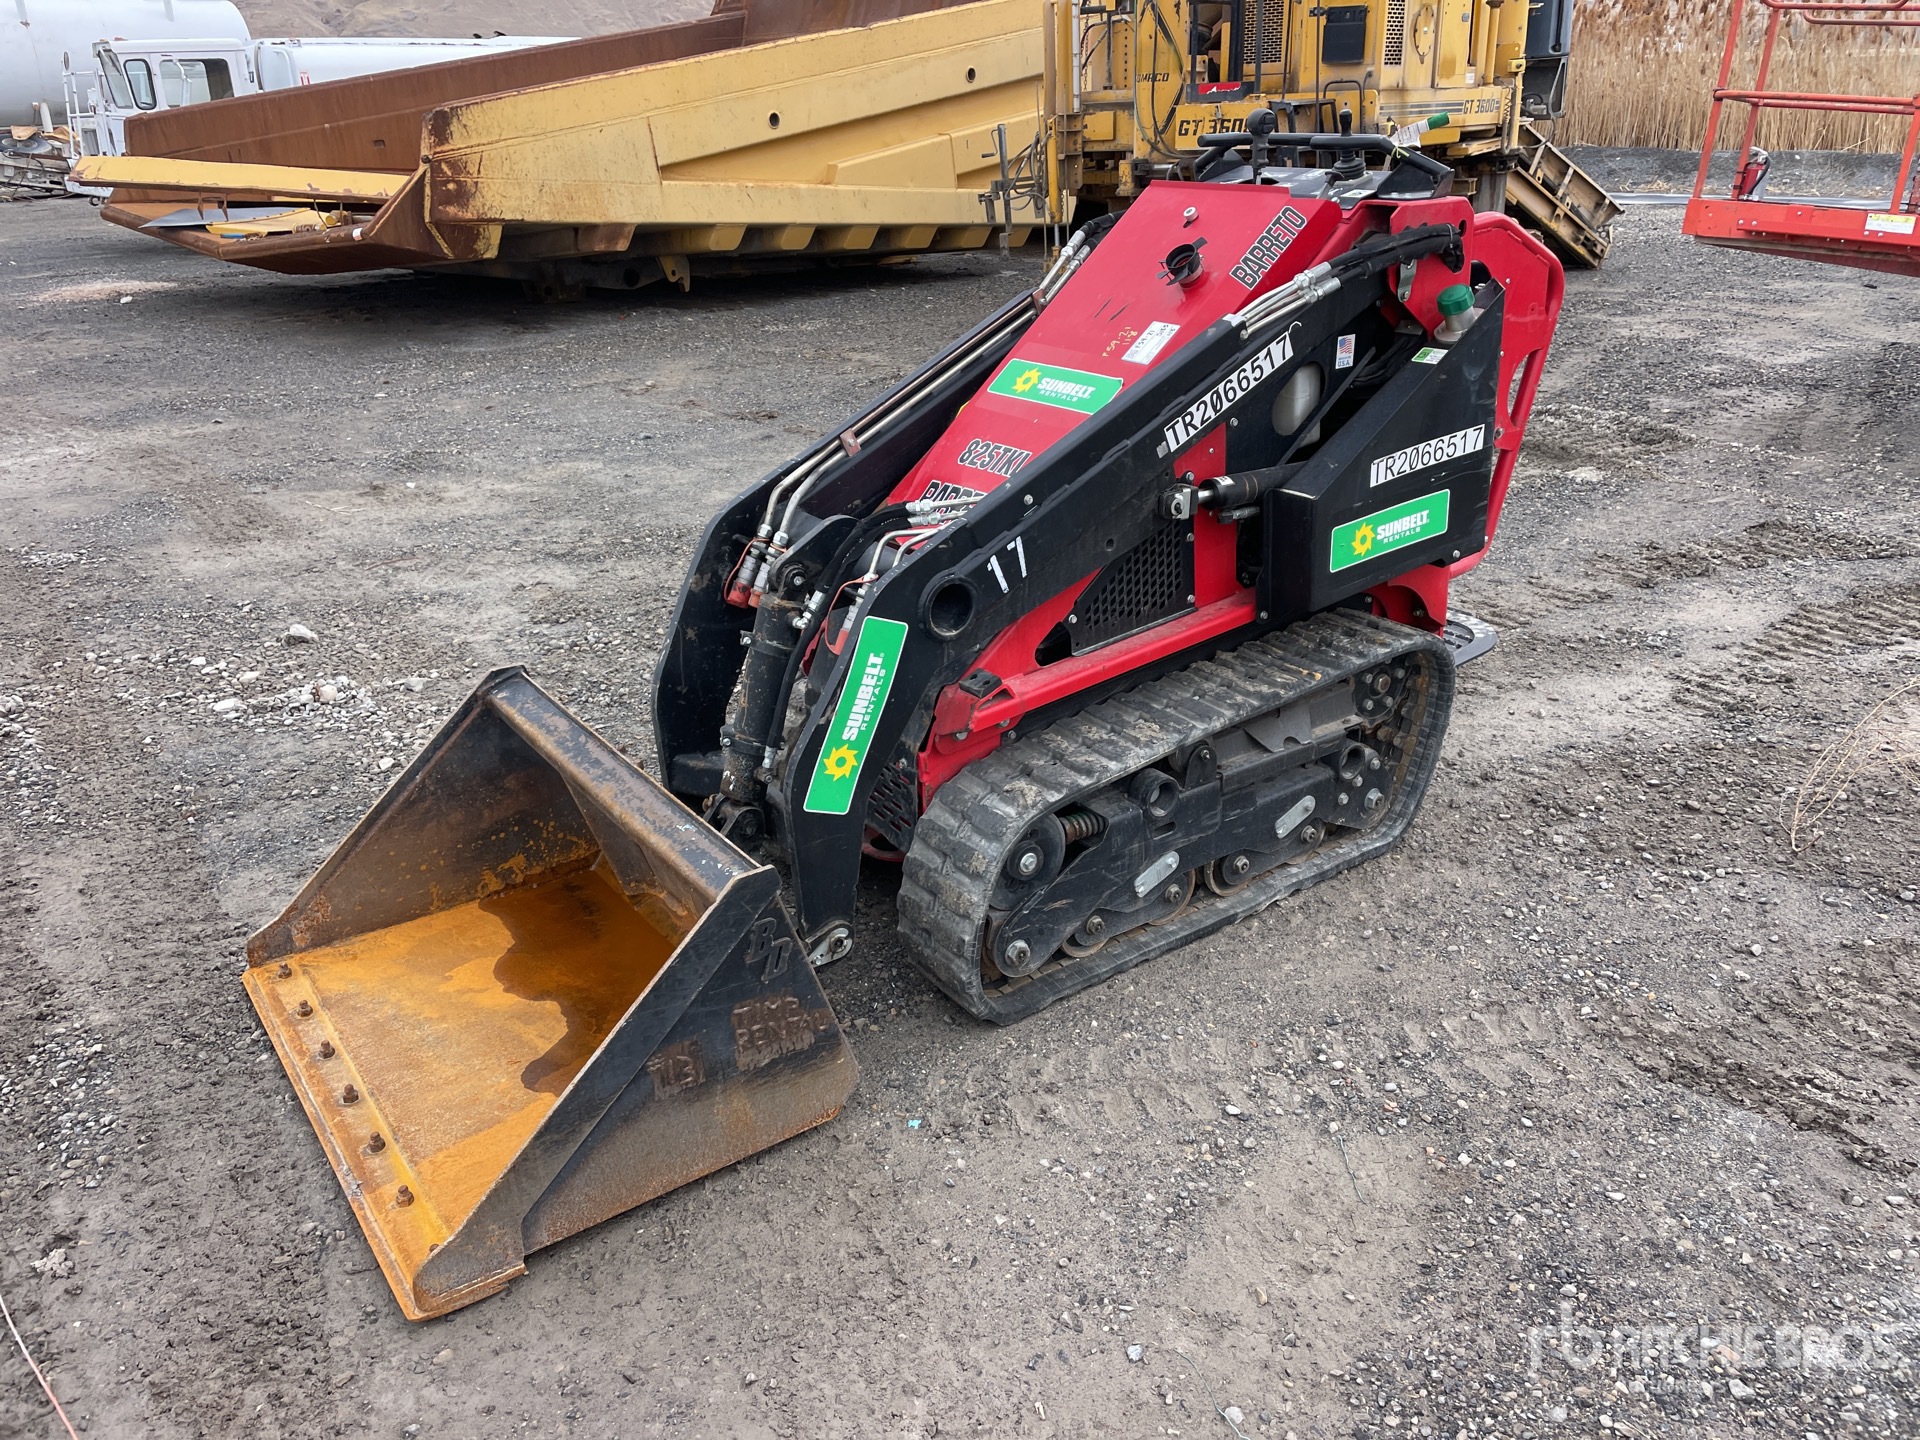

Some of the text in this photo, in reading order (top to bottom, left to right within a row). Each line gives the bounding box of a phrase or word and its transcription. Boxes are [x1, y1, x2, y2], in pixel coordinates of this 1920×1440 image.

[1178, 118, 1250, 136] GT 360
[1463, 98, 1496, 114] GT 3600
[1229, 206, 1307, 290] BARRETO
[1037, 377, 1096, 399] SUNBELT
[1039, 388, 1078, 402] RENTALS
[1166, 335, 1288, 447] TR2066517
[1372, 427, 1483, 484] TR2066517
[1376, 510, 1430, 540] SUNBELT
[1383, 527, 1421, 544] RENTALS
[986, 535, 1027, 594] 17
[842, 653, 884, 741] SUNBELT
[860, 669, 886, 731] RENTALS
